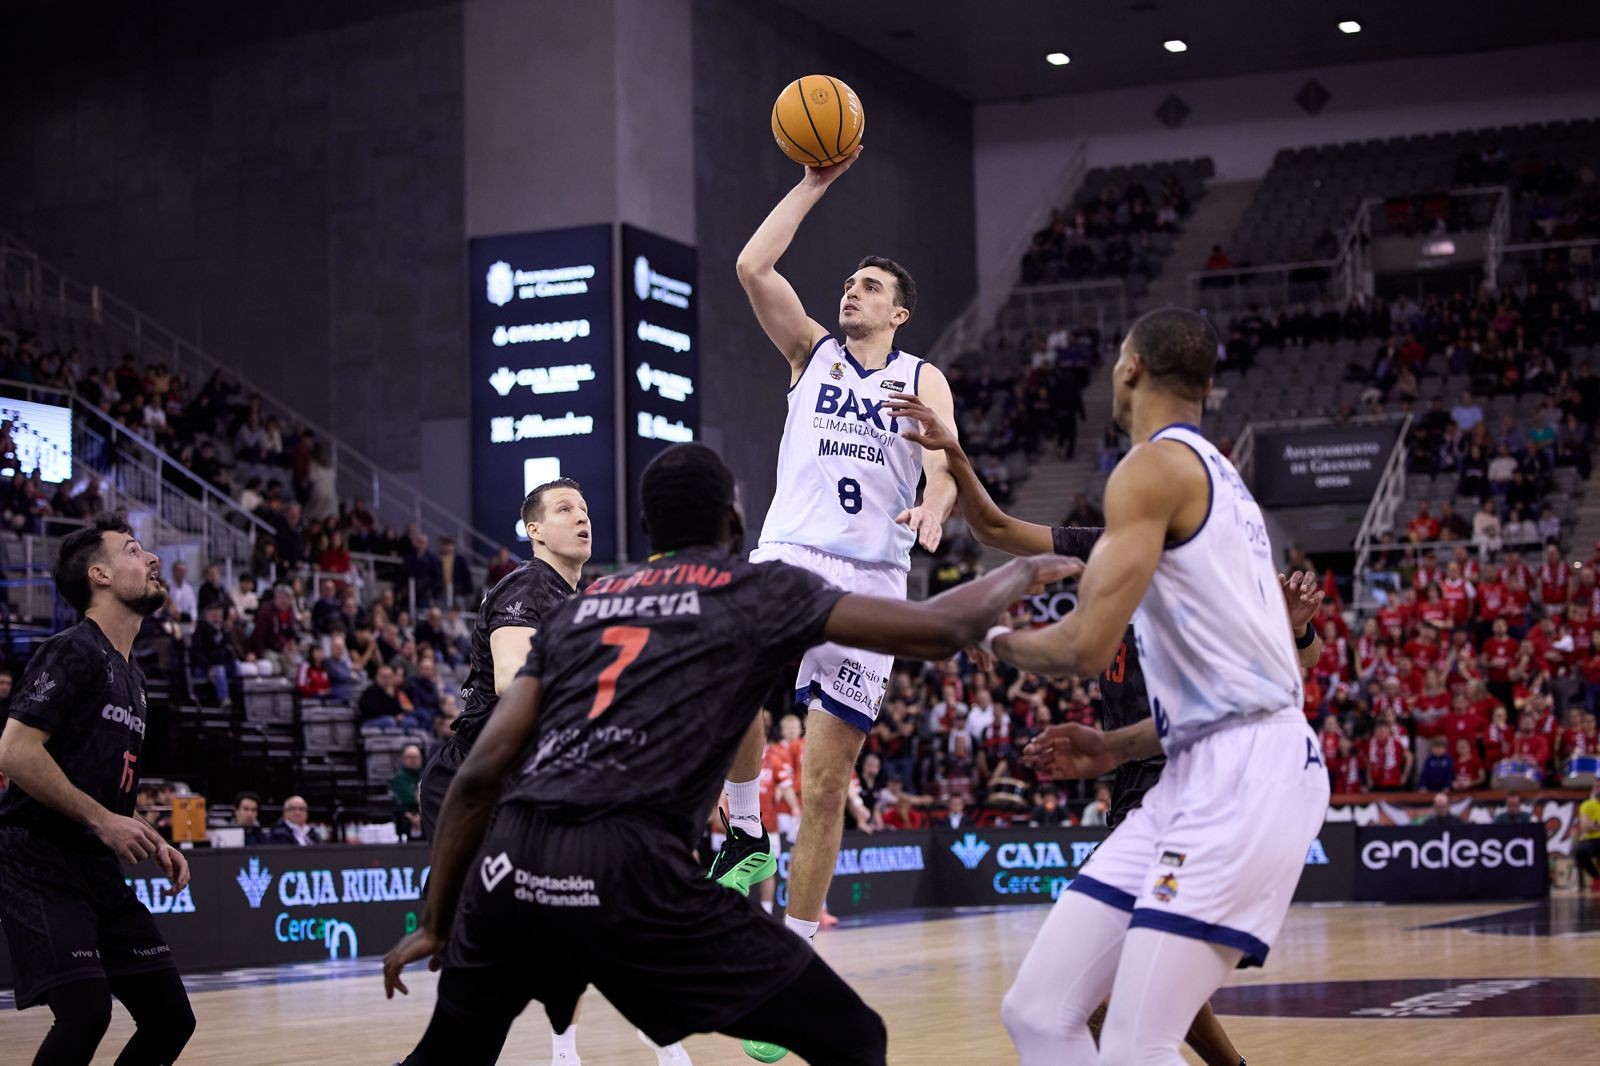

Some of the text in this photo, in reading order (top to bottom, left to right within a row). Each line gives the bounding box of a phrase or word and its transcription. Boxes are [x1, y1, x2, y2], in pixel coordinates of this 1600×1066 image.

[818, 438, 885, 466] MANRESA
[837, 476, 863, 515] 8
[573, 590, 700, 624] PULEVA
[588, 625, 651, 720] 7
[837, 666, 862, 688] ETL
[832, 680, 873, 710] GLOBAL
[996, 842, 1068, 870] CAJA
[1362, 832, 1534, 869] endesa
[278, 870, 339, 907] CAJA
[341, 867, 420, 903] RURAL
